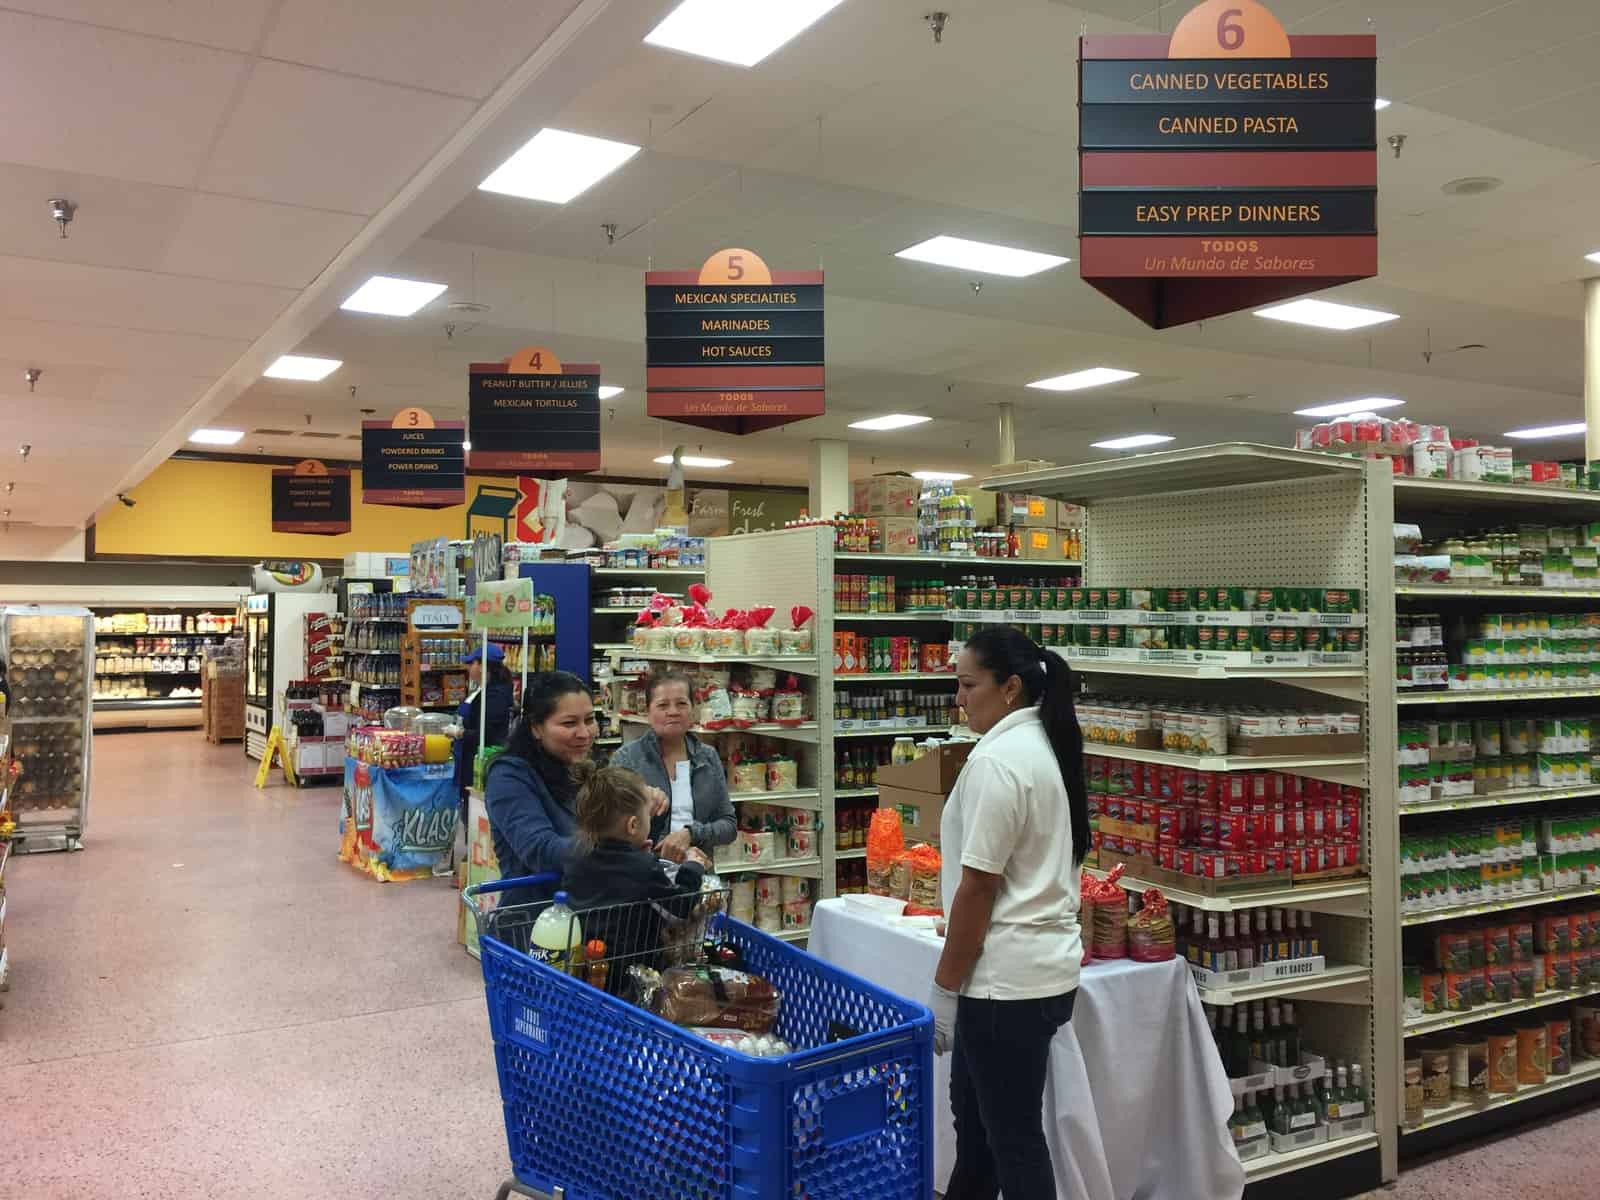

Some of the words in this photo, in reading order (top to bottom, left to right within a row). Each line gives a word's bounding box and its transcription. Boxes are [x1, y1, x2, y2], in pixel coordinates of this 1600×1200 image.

[1216, 9, 1245, 50] 6
[1130, 73, 1208, 90] CANNED
[1214, 73, 1329, 89] VEGETABLES
[1158, 117, 1237, 134] CANNED
[1243, 117, 1298, 134] PASTA
[1136, 206, 1181, 222] EASY
[1186, 206, 1232, 222] PREP
[1239, 205, 1320, 222] DINNERS
[1201, 240, 1259, 253] TODOS
[727, 256, 745, 280] 5
[1144, 256, 1167, 271] Un
[1170, 256, 1226, 271] Mundo
[1230, 256, 1250, 271] de
[1254, 256, 1315, 271] Sabores
[675, 293, 728, 304] MEXICAN
[730, 292, 797, 304] SPECIALTIES
[702, 320, 770, 331] MARINADES
[702, 346, 726, 357] HOT
[729, 346, 772, 357] SAUCES
[529, 352, 542, 371] 4
[482, 380, 516, 388] PEANUT
[519, 380, 551, 388] BUTTER
[558, 380, 588, 388] JELLIES
[494, 399, 532, 408] MEXICAN
[535, 399, 577, 408] TORTILLAS
[720, 393, 753, 401] TODOS
[408, 412, 419, 426] 3
[388, 463, 413, 471] POWER
[414, 463, 439, 471] DRINKS
[732, 500, 766, 517] Fresh
[1275, 965, 1288, 976] HOT
